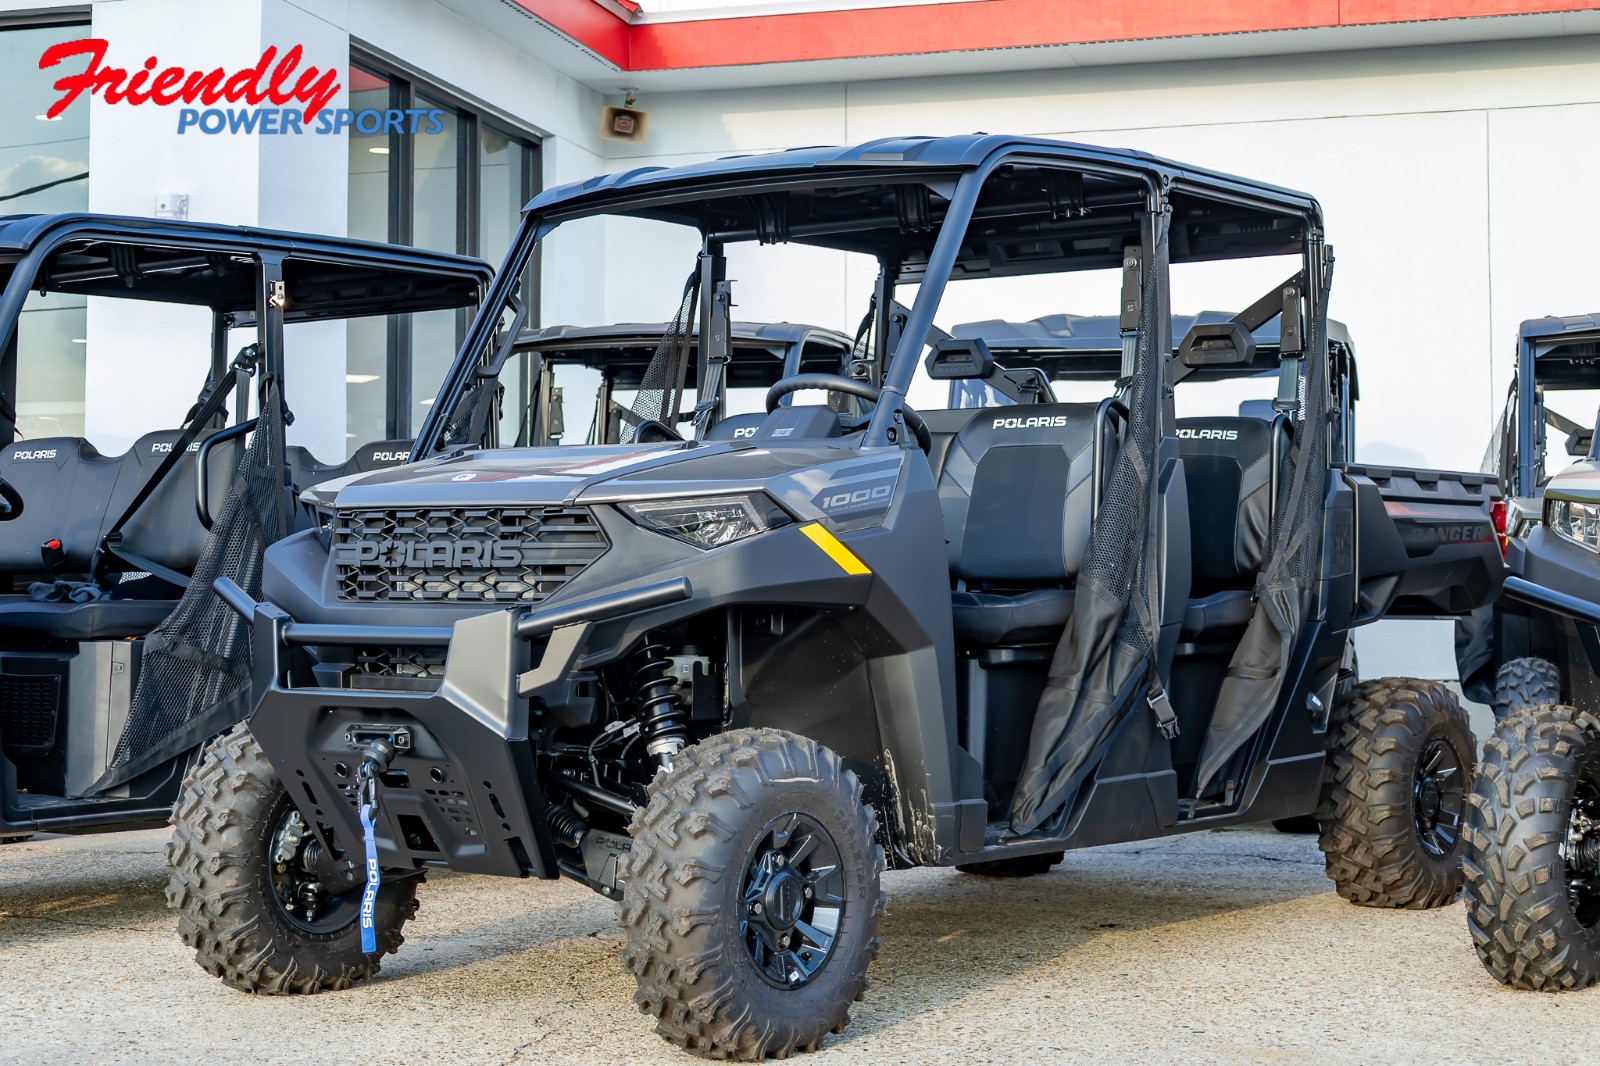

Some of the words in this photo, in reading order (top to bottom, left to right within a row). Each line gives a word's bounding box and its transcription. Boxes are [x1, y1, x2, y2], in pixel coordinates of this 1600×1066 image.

[992, 416, 1067, 430] POLARIS
[13, 449, 57, 460] POLARIS
[151, 441, 201, 452] POLIS
[373, 451, 410, 461] POLAR
[822, 485, 891, 509] 1000
[1411, 525, 1486, 541] RANGER
[353, 540, 525, 568] POLARIS
[595, 836, 632, 853] POLA
[362, 858, 378, 929] POLARIS
